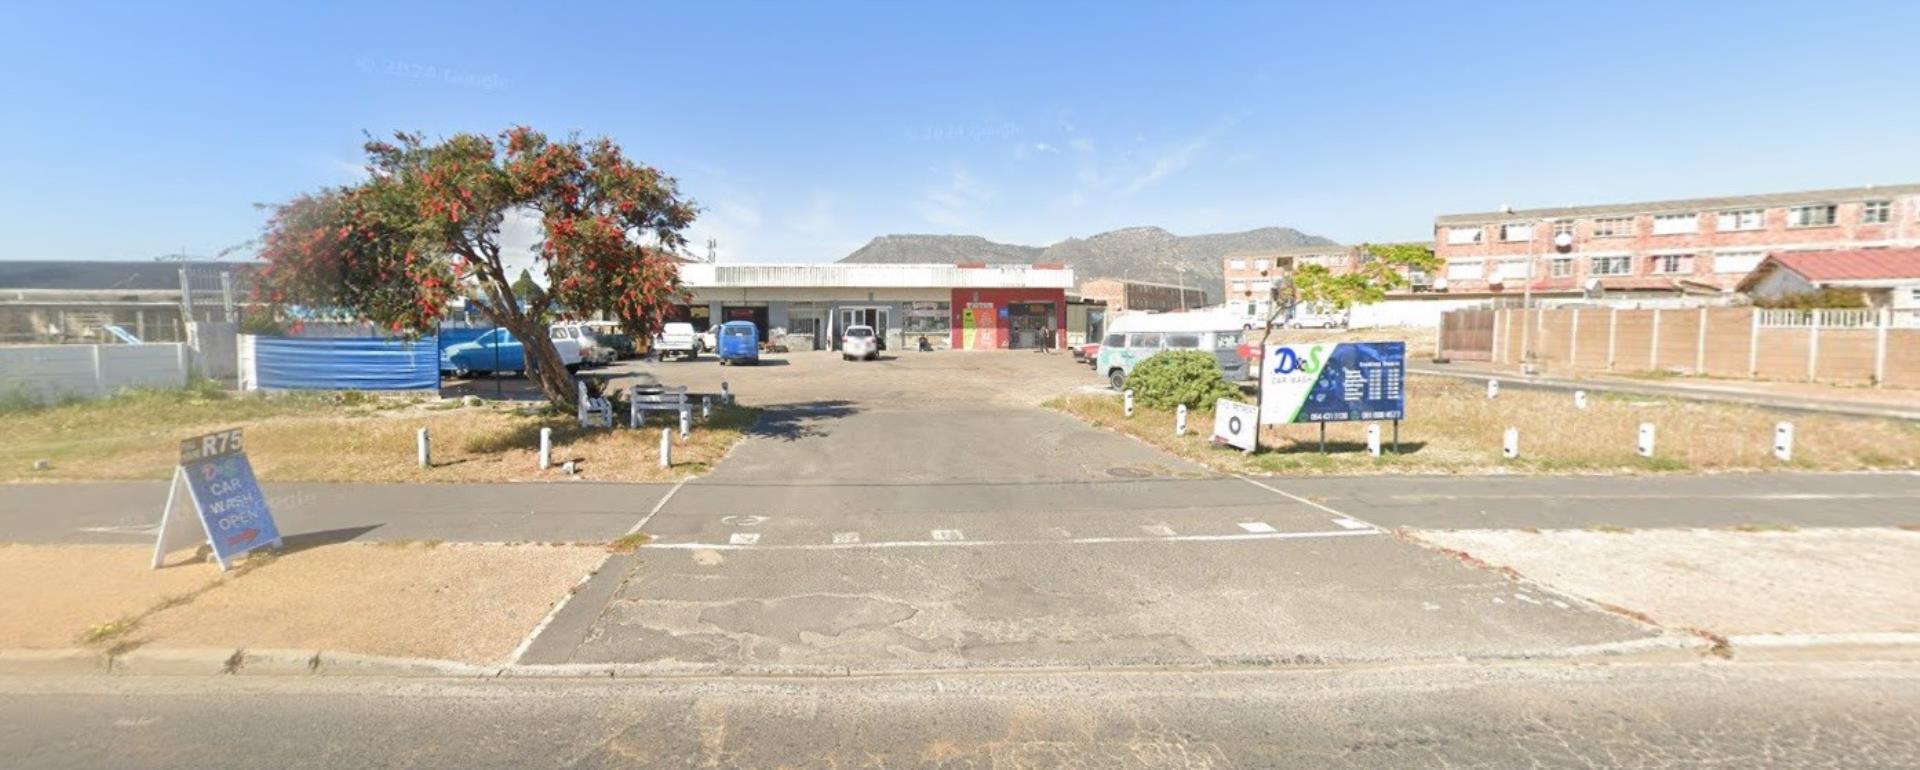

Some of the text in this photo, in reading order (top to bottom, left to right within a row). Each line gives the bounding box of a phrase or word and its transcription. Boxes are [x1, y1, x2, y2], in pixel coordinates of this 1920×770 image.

[1274, 345, 1322, 374] D&S
[202, 430, 242, 457] R75
[210, 478, 242, 496] CAR
[209, 494, 253, 514] WASH
[218, 511, 258, 530] OPEN
